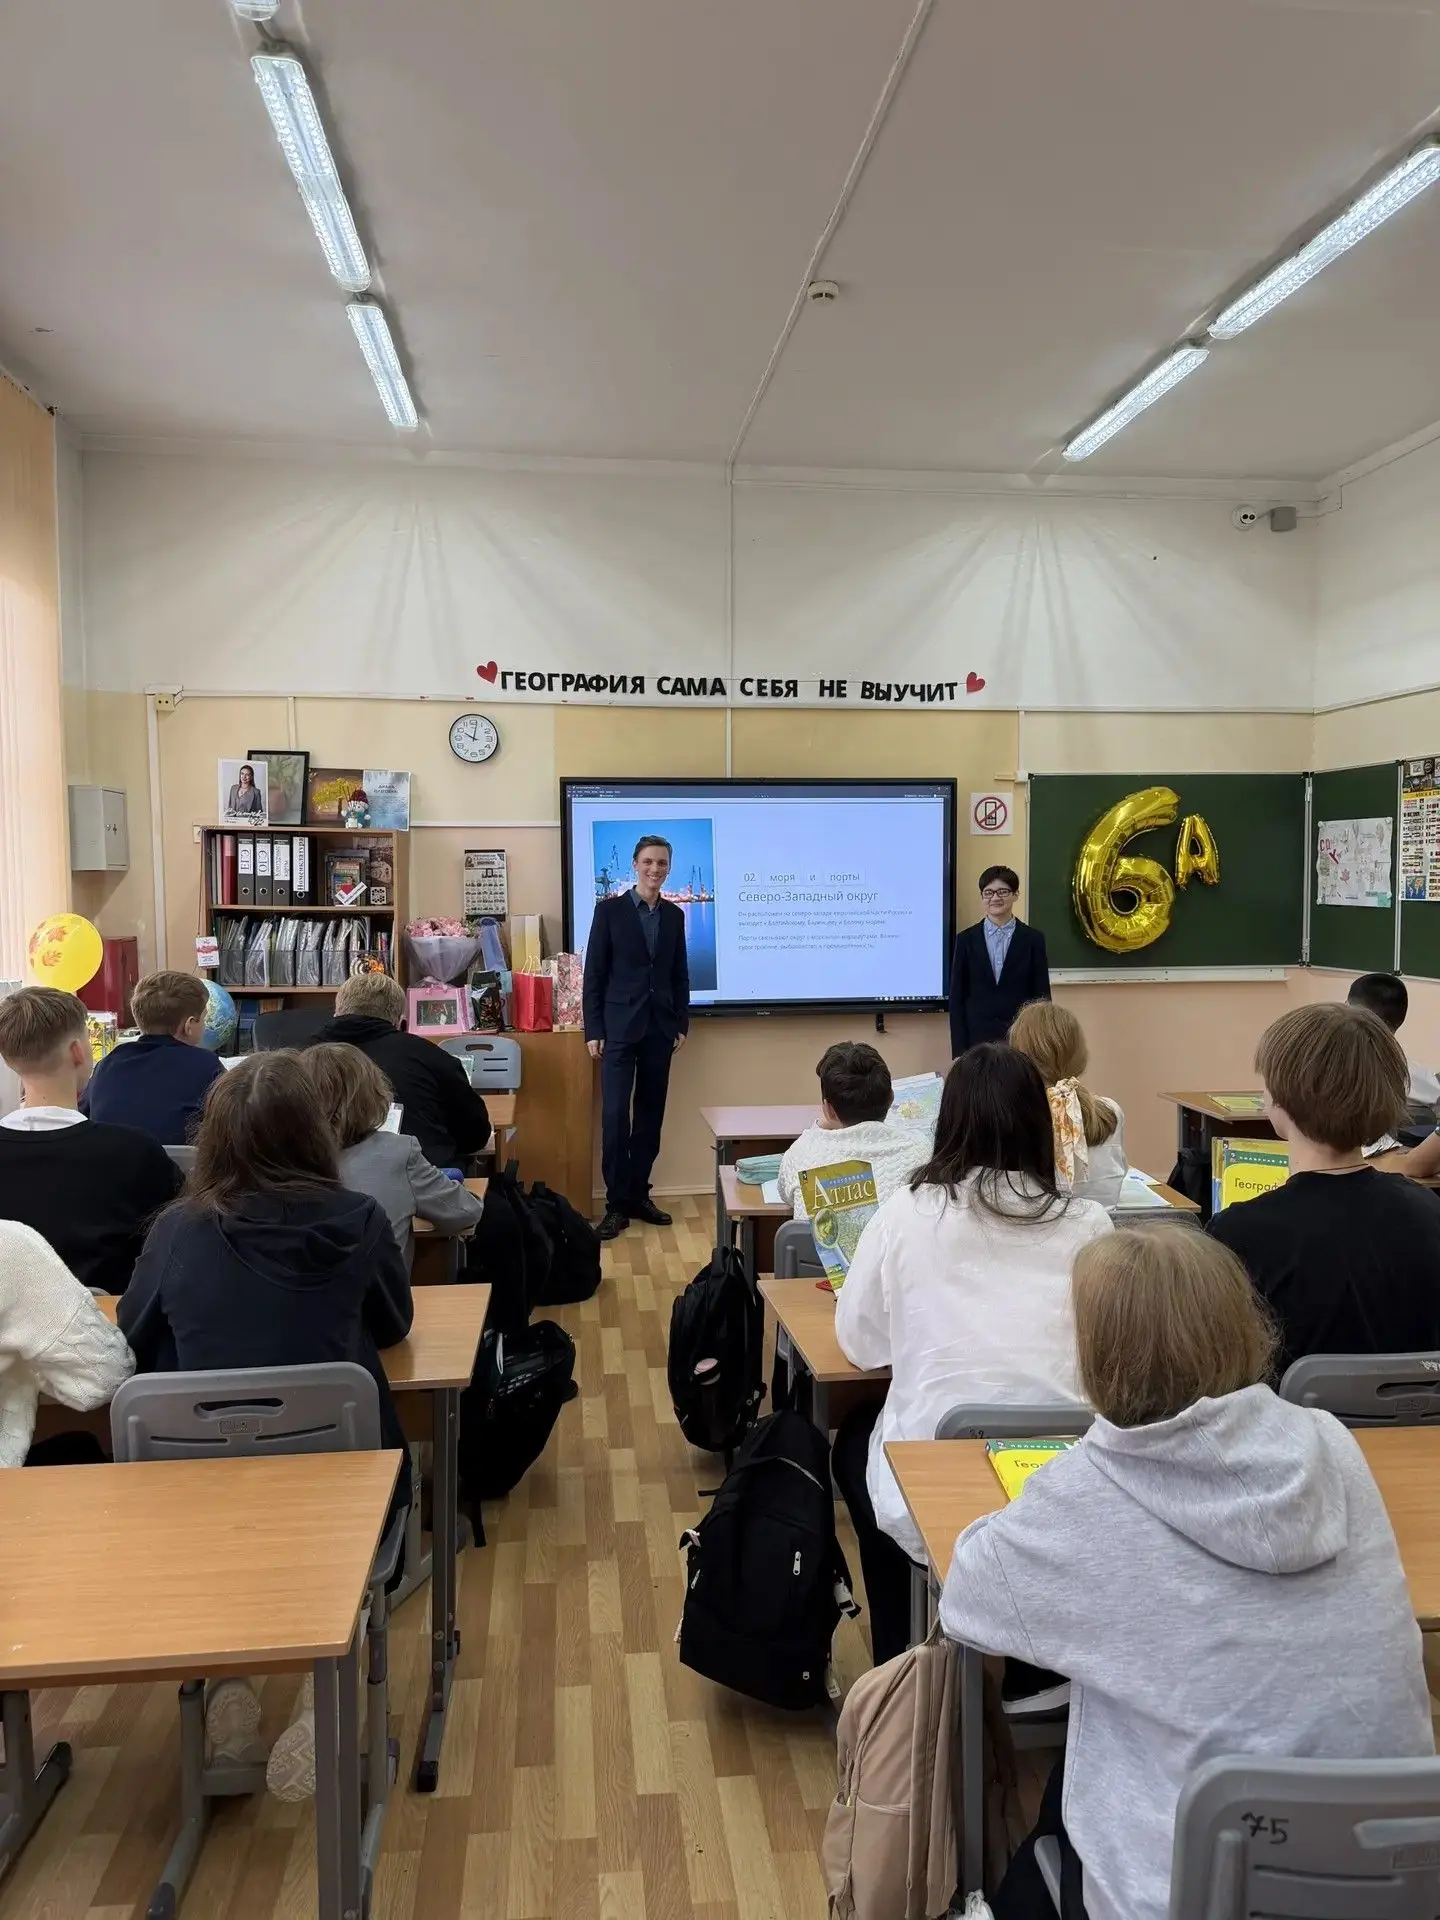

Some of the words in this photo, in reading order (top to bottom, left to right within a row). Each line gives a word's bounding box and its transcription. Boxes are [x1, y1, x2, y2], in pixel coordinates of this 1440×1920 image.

[500, 670, 645, 695] ГЕОГРАФИЯ
[656, 675, 727, 697] САМА
[739, 677, 799, 698] СЕБЯ
[818, 679, 847, 698] НЕ
[859, 681, 959, 702] ВЫУЧИТ
[240, 849, 250, 870] ЕГЭ
[258, 850, 268, 873] ОГЭ
[297, 837, 305, 891] Номенклатура
[743, 873, 756, 882] 02
[770, 873, 796, 883] моря
[830, 872, 860, 882] порты
[738, 890, 844, 904] Северо-Западный
[847, 890, 879, 904] округ
[812, 1175, 875, 1211] Атлас
[1014, 1459, 1045, 1469] Гео
[1241, 1811, 1290, 1845] 75
